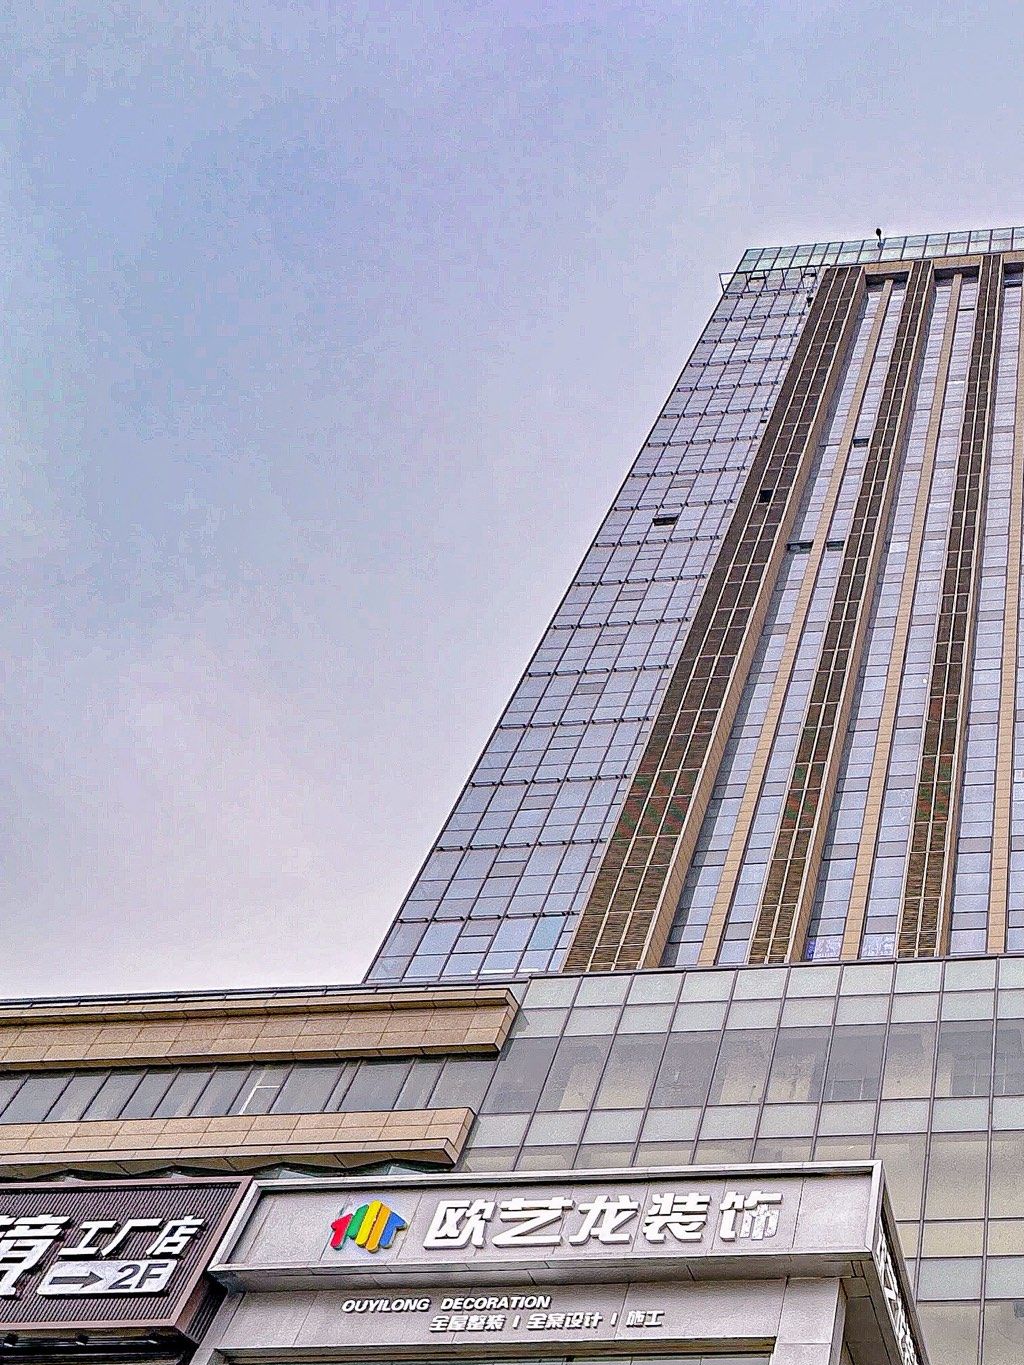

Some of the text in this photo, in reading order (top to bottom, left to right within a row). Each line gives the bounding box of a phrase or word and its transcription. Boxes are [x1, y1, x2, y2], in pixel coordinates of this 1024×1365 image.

[422, 1190, 784, 1250] 欧艺龙装饰
[58, 1215, 204, 1257] 工厂店
[107, 1263, 169, 1290] 2F
[341, 1295, 552, 1313] OUYILONG DECORATION
[429, 1310, 666, 1333] 全屋整装 全案设计 施工
